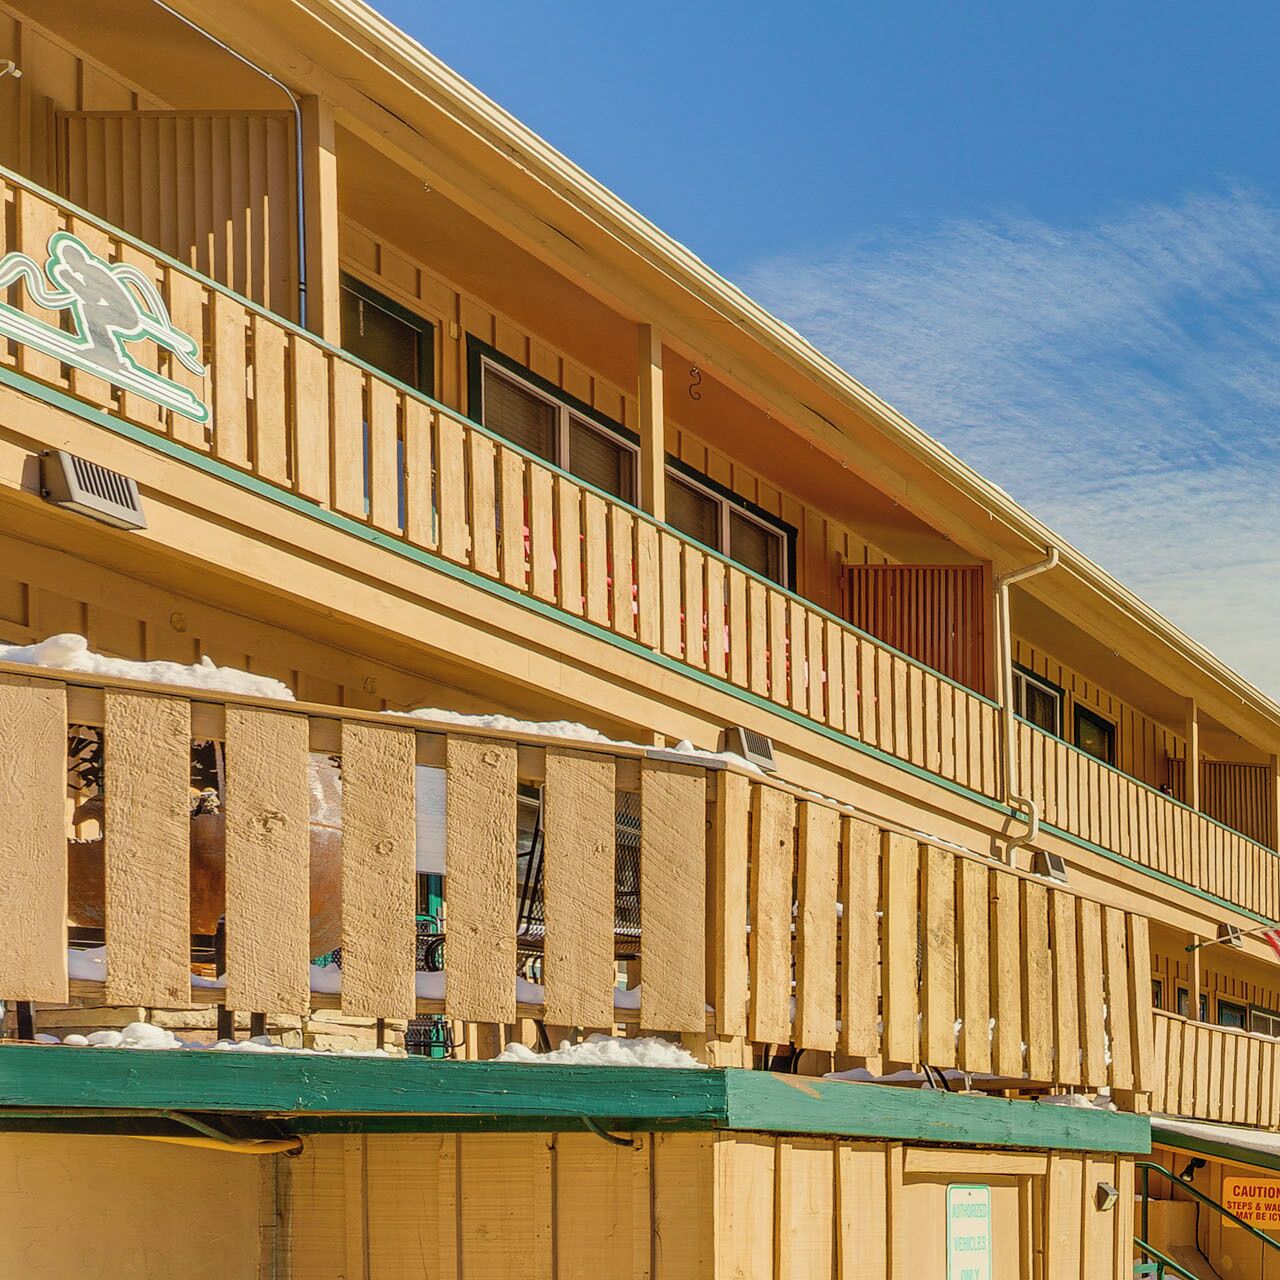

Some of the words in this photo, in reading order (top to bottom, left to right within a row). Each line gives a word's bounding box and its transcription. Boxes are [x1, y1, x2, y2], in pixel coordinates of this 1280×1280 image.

[1227, 1201, 1253, 1210] STEPS
[1255, 1203, 1261, 1211] &
[1235, 1211, 1253, 1221] MAY
[1256, 1212, 1266, 1221] BE
[954, 1235, 986, 1252] VEHICLES
